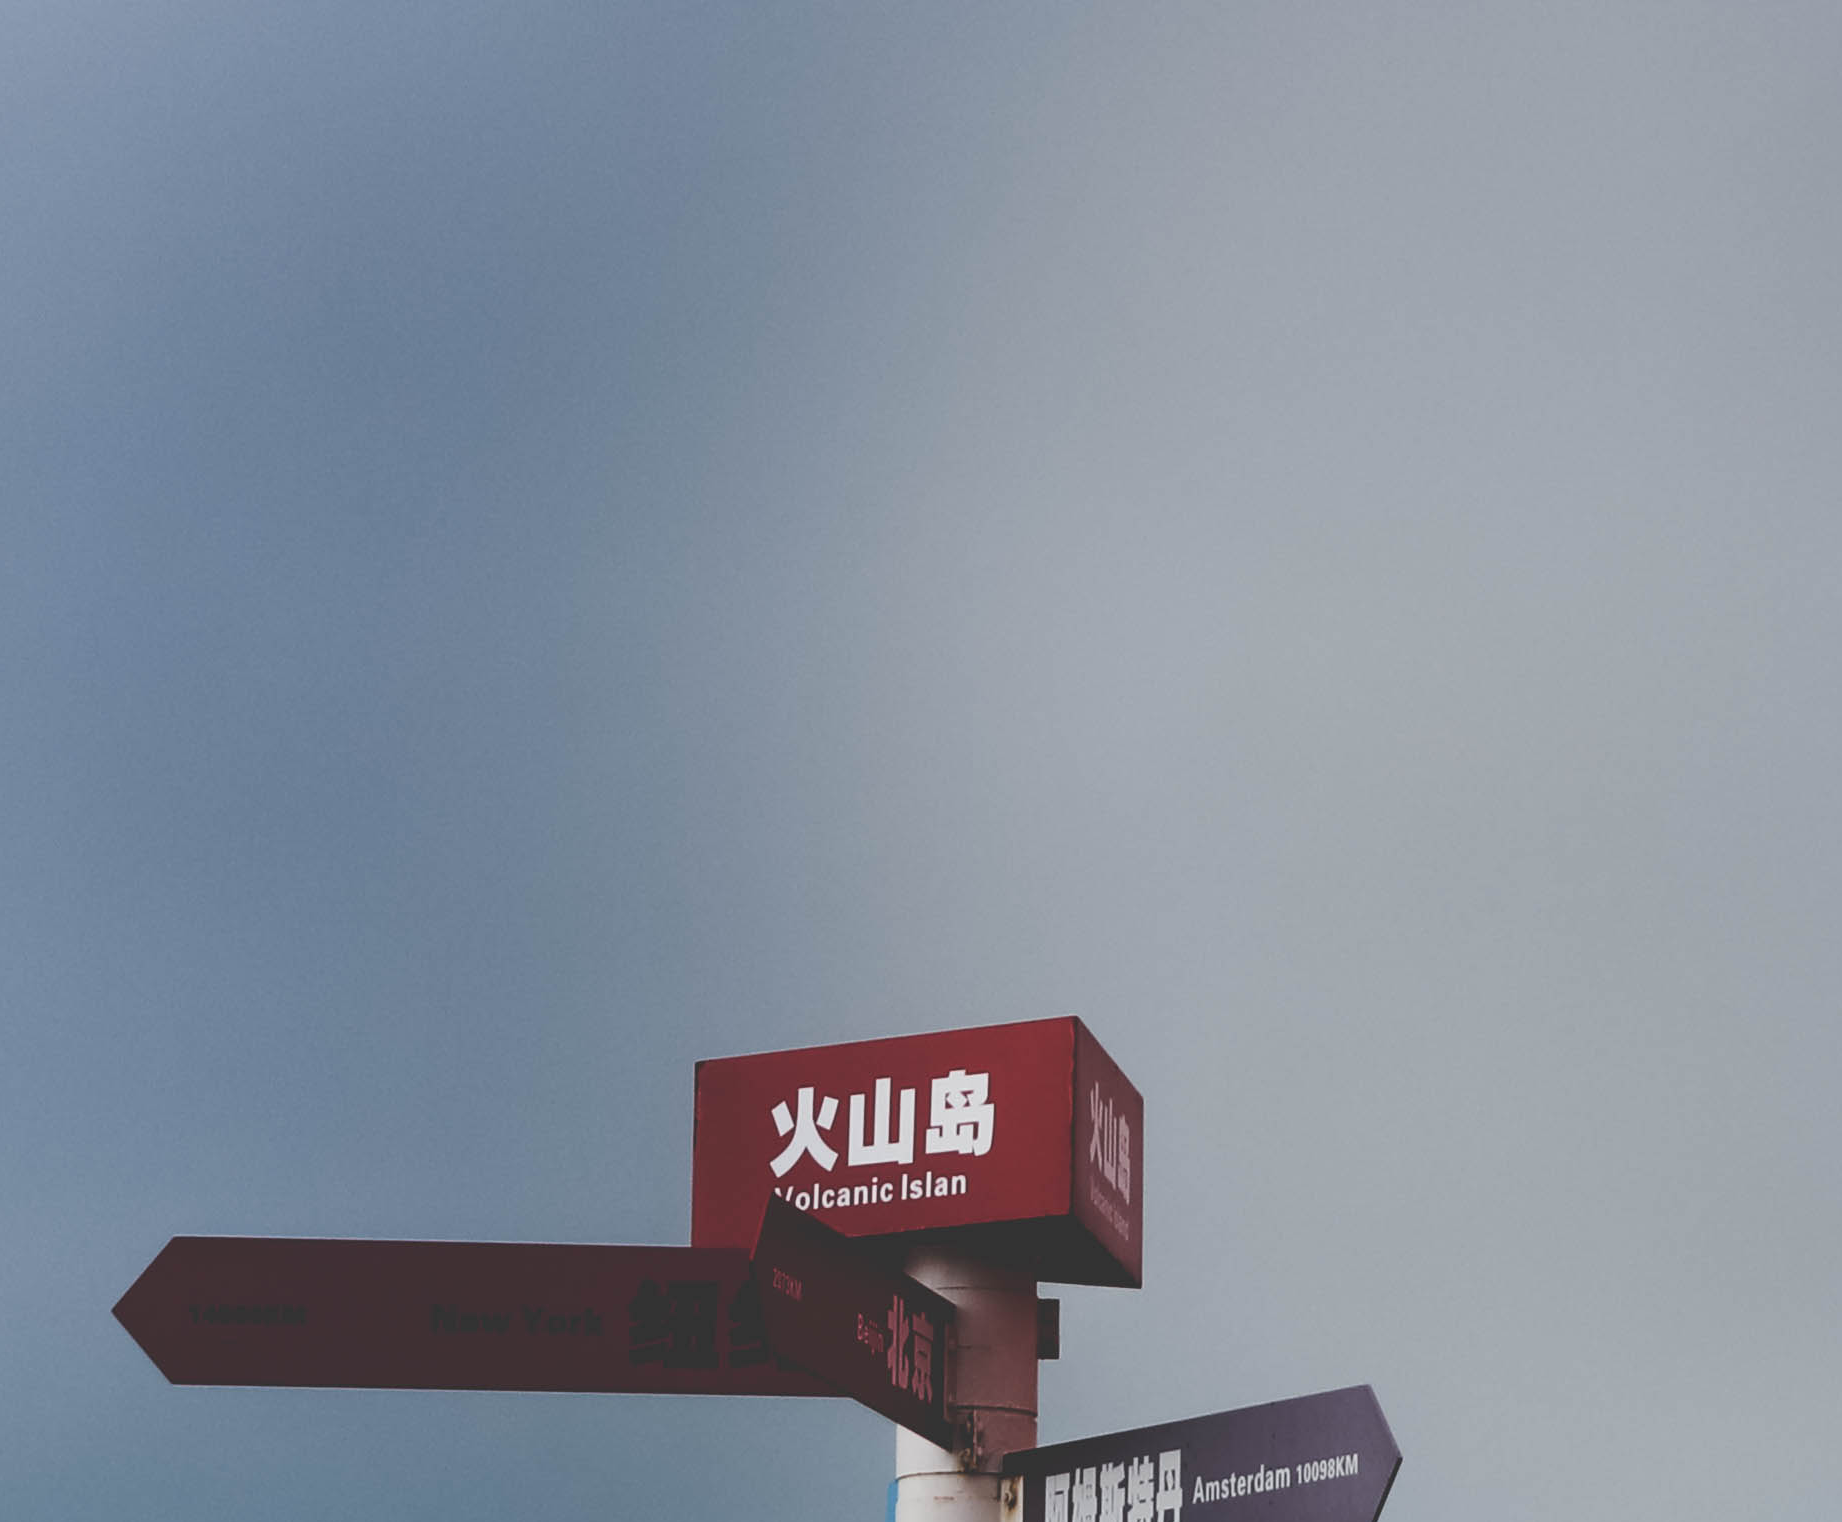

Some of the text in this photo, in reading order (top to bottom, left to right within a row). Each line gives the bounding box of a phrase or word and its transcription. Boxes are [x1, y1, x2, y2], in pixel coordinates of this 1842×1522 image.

[769, 1069, 995, 1179] 火山岛
[1089, 1080, 1131, 1206] 火山岛
[901, 1171, 968, 1201] Islan
[429, 1303, 510, 1336] New
[521, 1303, 604, 1338] York
[887, 1294, 934, 1404] 北京
[1192, 1463, 1291, 1505] Amsterdam
[1296, 1453, 1359, 1485] 10098KM
